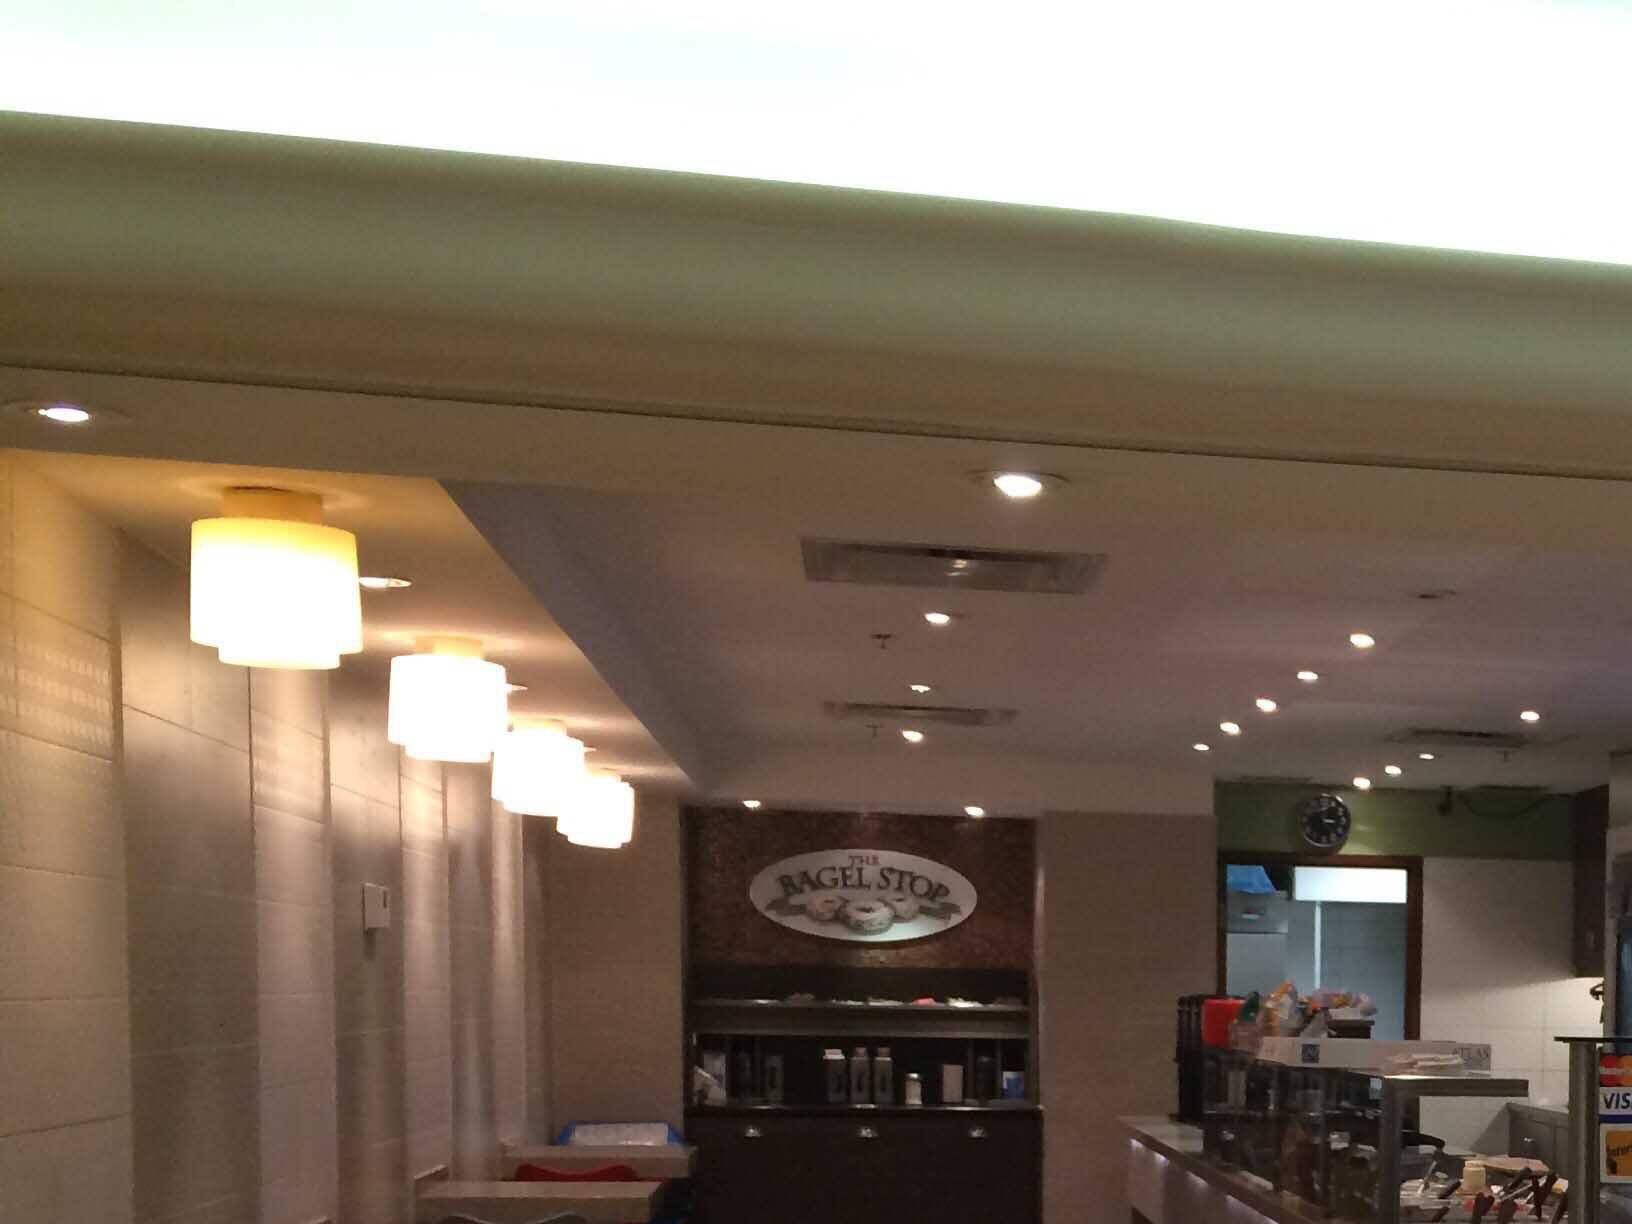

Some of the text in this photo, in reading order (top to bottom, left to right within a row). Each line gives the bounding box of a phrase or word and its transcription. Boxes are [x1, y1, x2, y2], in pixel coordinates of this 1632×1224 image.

[848, 855, 880, 866] THE
[777, 866, 950, 901] BAGEL STOP
